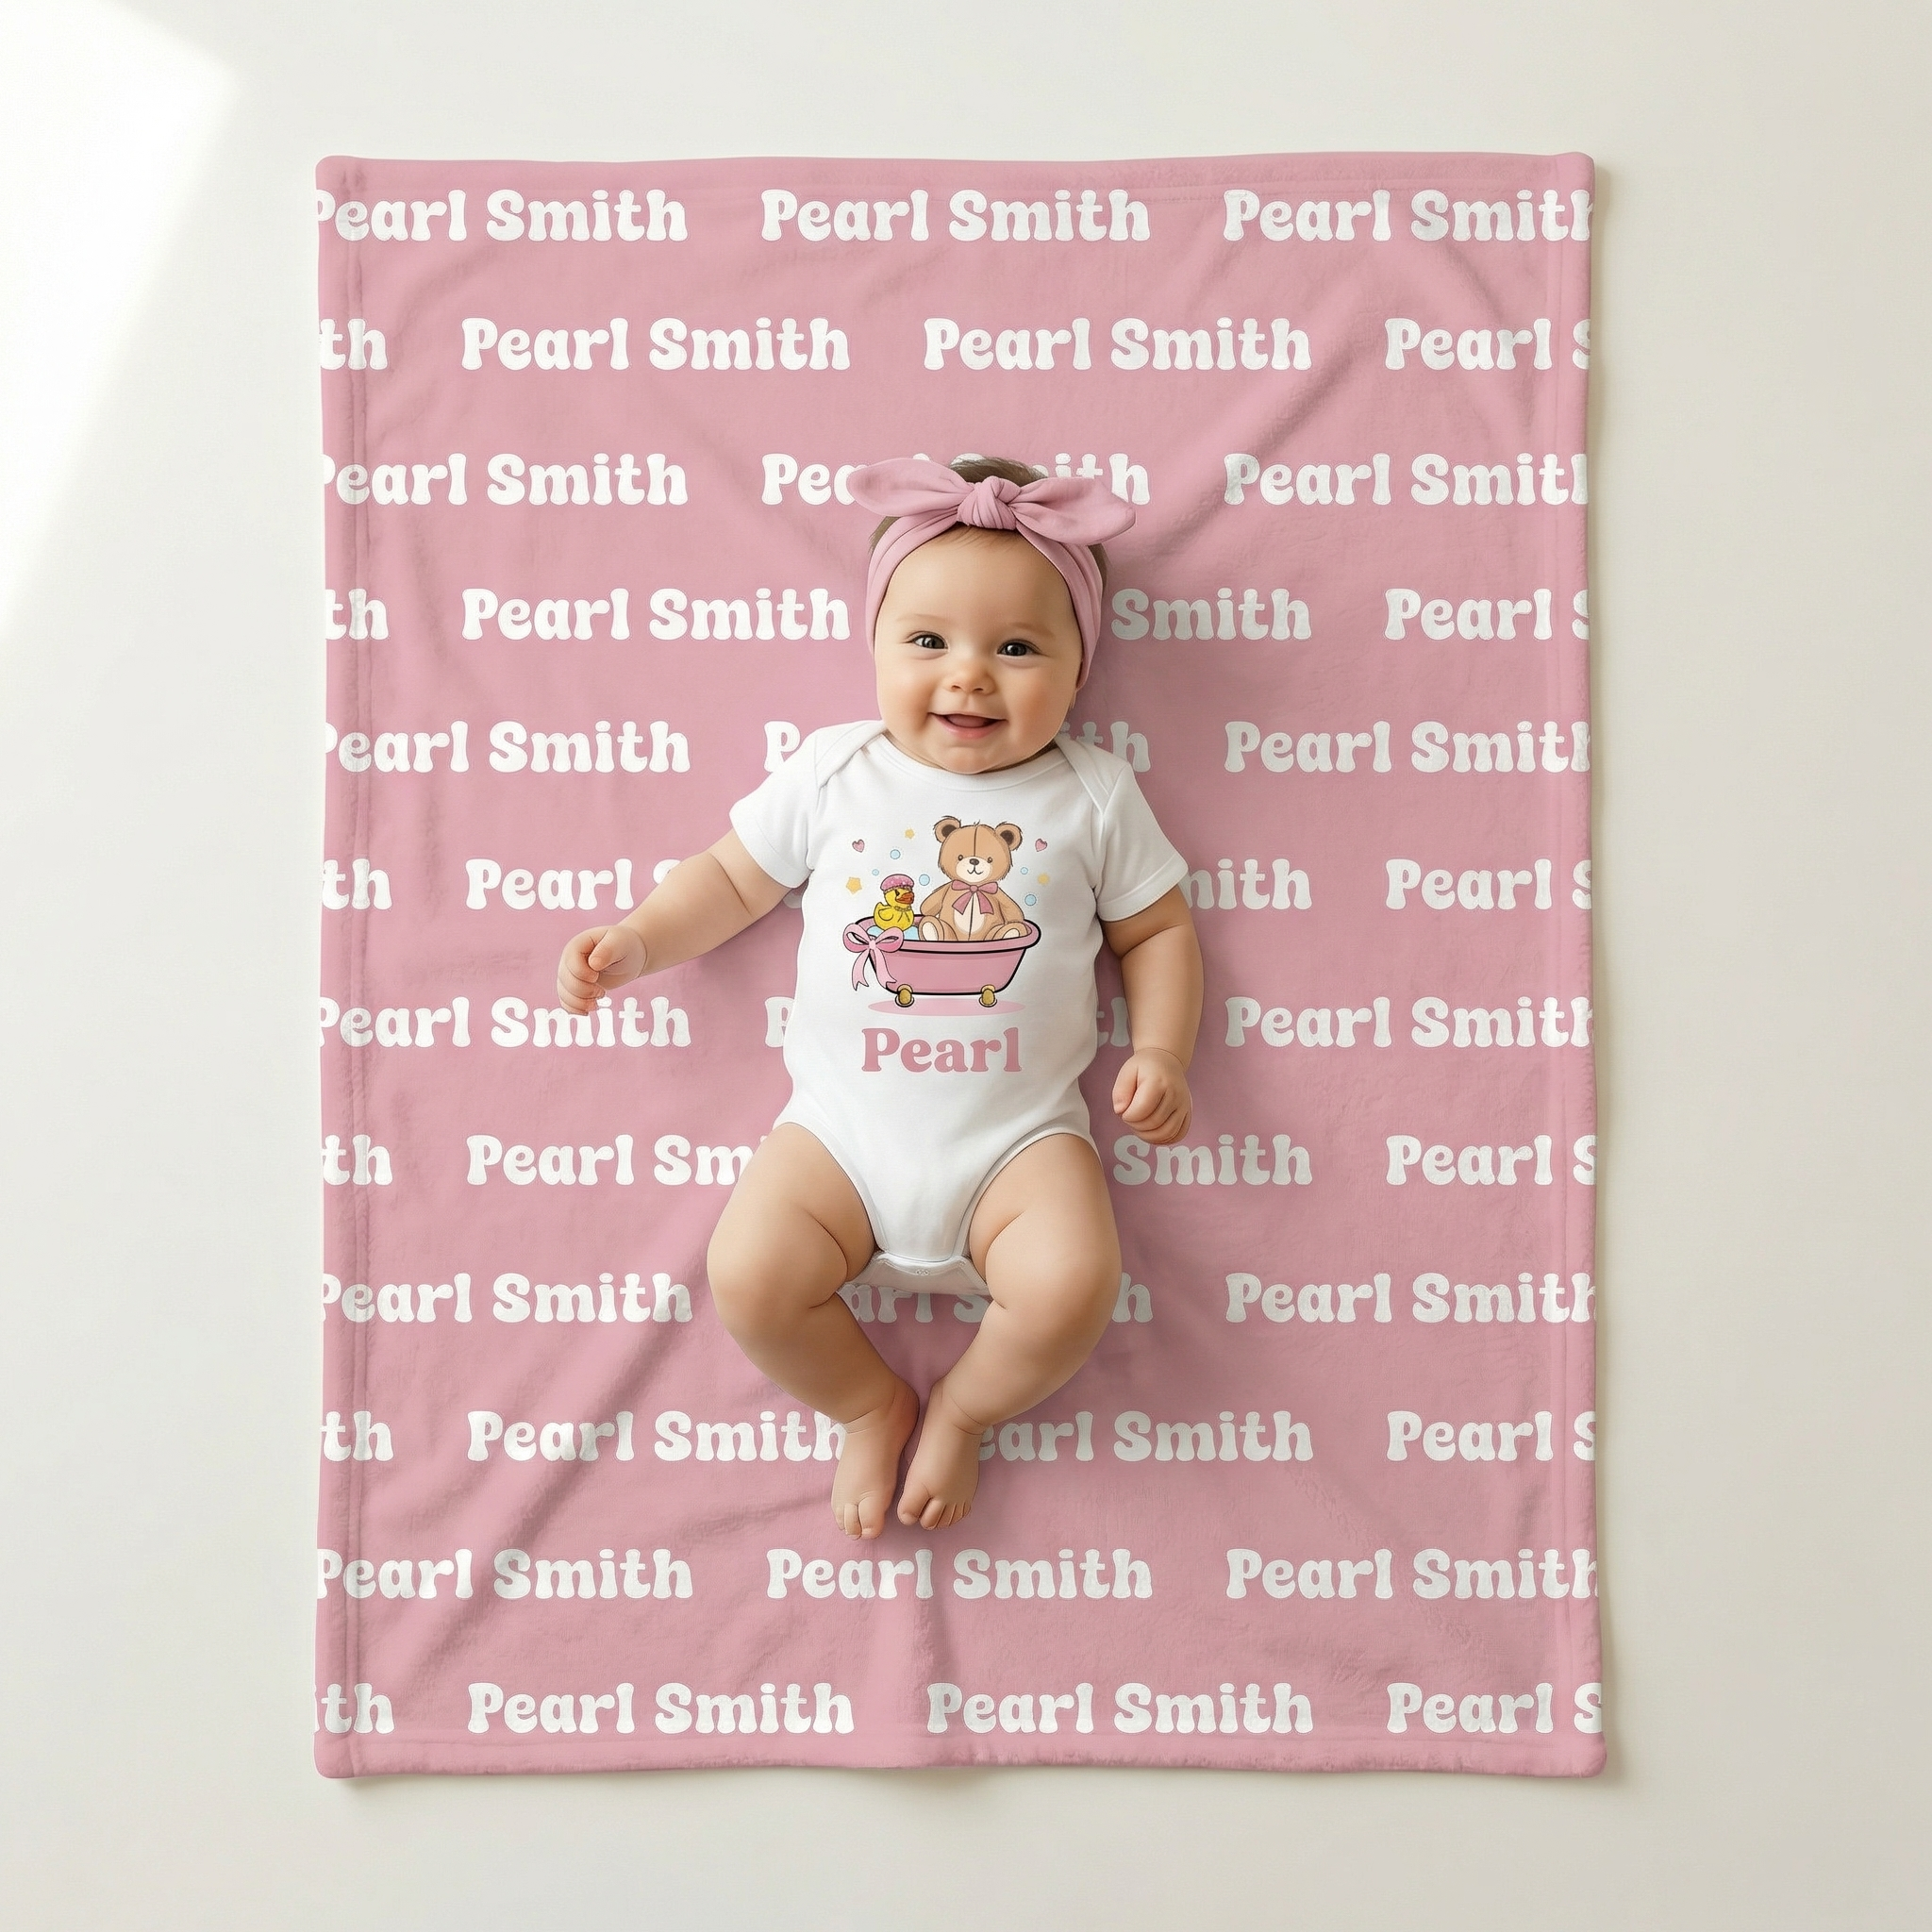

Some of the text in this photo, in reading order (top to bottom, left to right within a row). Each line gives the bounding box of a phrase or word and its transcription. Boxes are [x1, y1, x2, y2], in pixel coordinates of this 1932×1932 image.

[486, 189, 688, 242] Smith
[761, 189, 1151, 242] Pearl Smith
[1223, 189, 1391, 242] Pearl
[461, 317, 851, 371] Pearl Smith
[924, 317, 1312, 371] Pearl Smith
[1385, 317, 1553, 371] Pearl
[323, 453, 689, 506] earl Smith
[1224, 453, 1391, 506] Pearl
[462, 588, 850, 641] Pearl Smith
[1111, 588, 1311, 641] Smith
[1385, 588, 1552, 641] Pearl
[325, 721, 691, 774] earl Smith
[1224, 721, 1391, 773] Pearl
[465, 858, 634, 910] Pearl
[1386, 858, 1553, 910] Pearl
[491, 996, 691, 1048] Smith
[1225, 996, 1391, 1047] Pearl
[861, 1026, 1023, 1074] Pearl
[466, 1133, 635, 1186] Pearl
[1113, 1134, 1312, 1185] Smith
[1386, 1135, 1553, 1185] Pearl
[492, 1272, 692, 1324] Smith
[1226, 1273, 1392, 1323] Pearl
[467, 1410, 846, 1462] Pearl Smith
[1113, 1410, 1313, 1461] Smith
[1387, 1410, 1554, 1461] Pearl
[494, 1548, 693, 1600] Smith
[766, 1548, 1153, 1600] Pearl Smith
[1226, 1548, 1598, 1600] Pearl Smith
[468, 1682, 855, 1735] Pearl Smith
[927, 1682, 1314, 1734] Pearl Smith
[1387, 1682, 1554, 1734] Pearl
